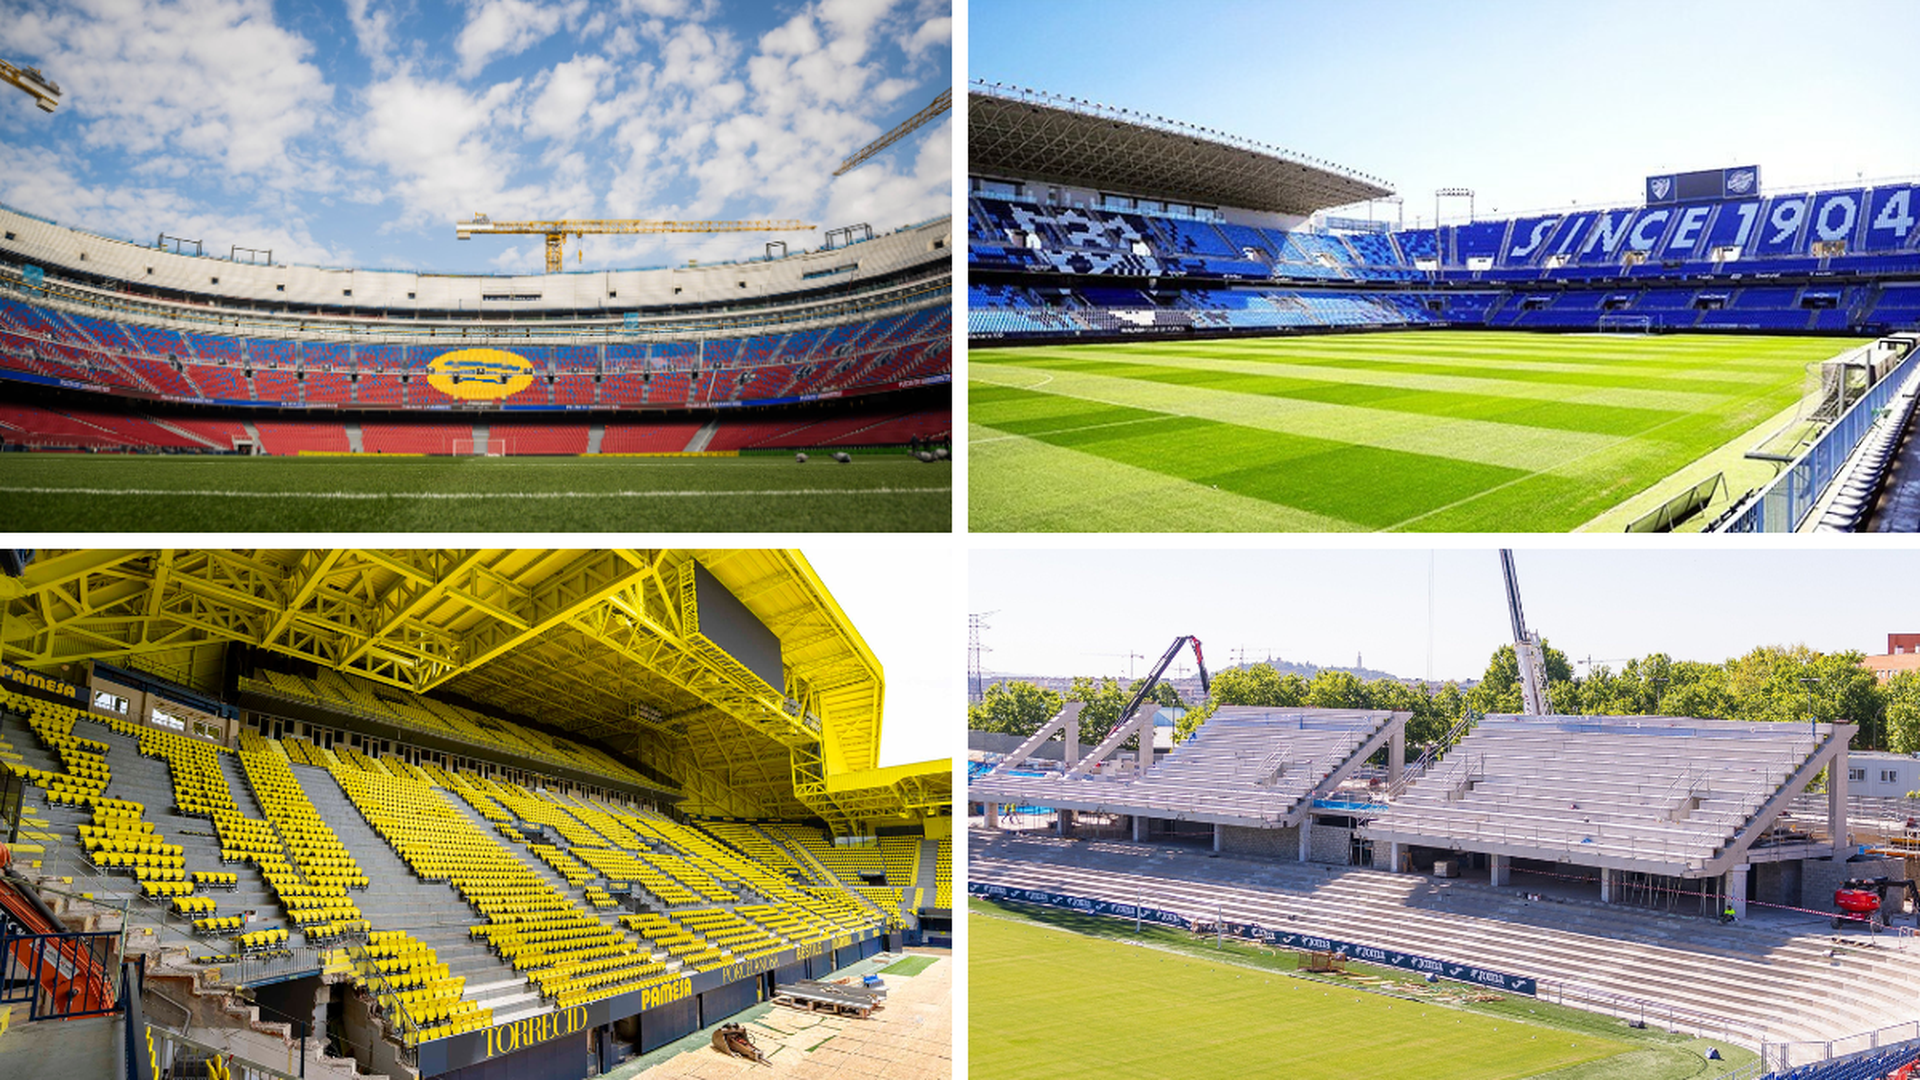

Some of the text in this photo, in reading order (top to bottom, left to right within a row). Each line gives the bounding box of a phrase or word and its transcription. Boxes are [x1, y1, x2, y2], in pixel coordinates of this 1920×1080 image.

[1510, 189, 1914, 258] SINCE 1904
[0, 663, 76, 698] PAMESA
[641, 977, 692, 1011] PAMESA
[481, 1005, 588, 1058] TORRECID
